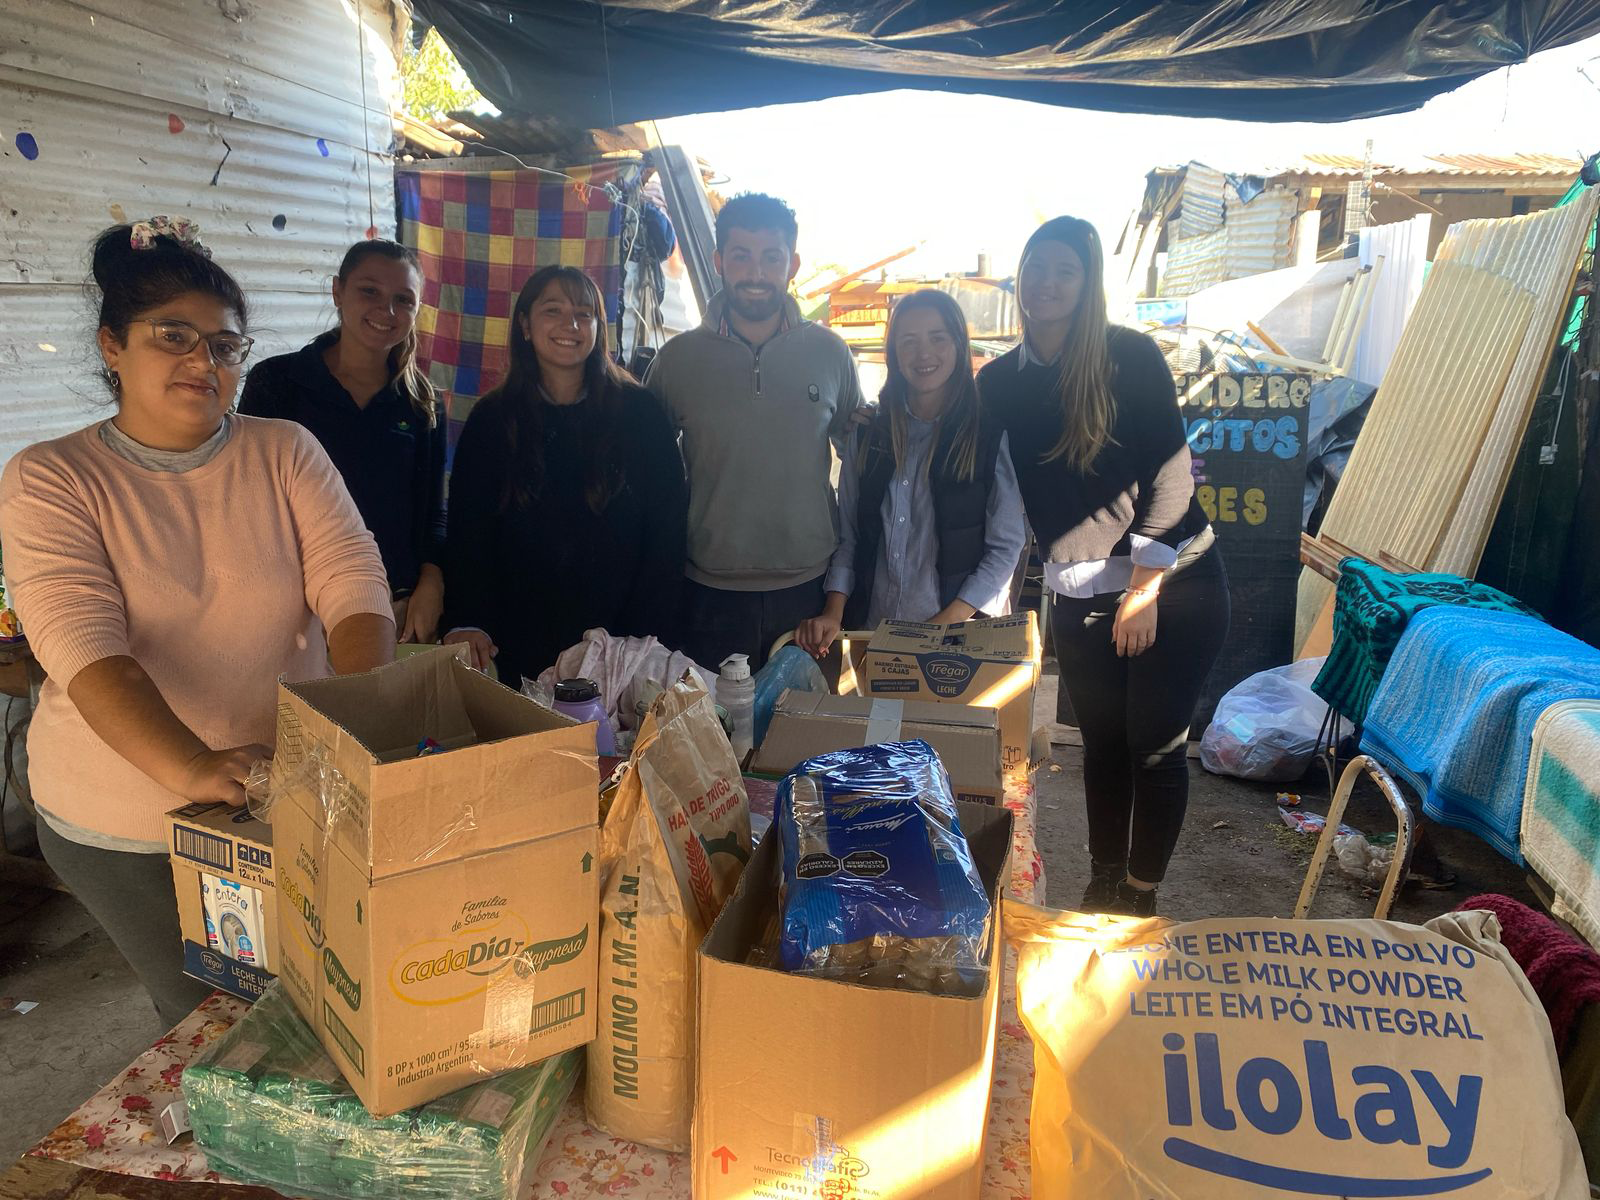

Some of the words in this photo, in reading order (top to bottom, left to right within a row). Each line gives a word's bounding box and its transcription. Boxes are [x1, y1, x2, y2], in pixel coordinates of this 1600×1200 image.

[1175, 375, 1311, 408] ENDERO
[1191, 459, 1206, 483] E
[1196, 485, 1268, 526] BES
[930, 663, 967, 679] Tregar
[936, 685, 957, 694] LECHE
[689, 796, 706, 816] DE
[706, 778, 731, 805] TRIGO
[709, 806, 726, 822] TIPO
[238, 861, 264, 873] CONTENIDO:
[215, 887, 249, 911] entera
[461, 895, 508, 915] Familia
[451, 920, 463, 932] de
[464, 910, 500, 926] Sabores
[202, 953, 223, 970] Tregar
[1208, 930, 1322, 959] ENTERA
[1329, 933, 1368, 961] EN
[1376, 940, 1476, 969] POLVO
[231, 965, 256, 983] LECHE
[324, 952, 359, 1004] Mayonesa
[1132, 958, 1241, 986] WHOLE
[1247, 961, 1322, 992] MILK
[1329, 968, 1467, 1003] POWDER
[238, 978, 264, 996] ENTER
[1130, 991, 1213, 1019] LEITE
[1220, 994, 1261, 1020] EM
[1272, 992, 1312, 1024] PÓ
[1322, 1005, 1484, 1041] INTEGRAL
[612, 993, 639, 1100] MOLINO
[387, 1066, 393, 1078] 8
[395, 1062, 407, 1076] DP
[409, 1061, 414, 1070] x
[416, 1051, 436, 1068] 1000
[397, 1064, 434, 1088] Industria
[435, 1051, 474, 1072] Argentina
[1162, 1032, 1483, 1168] ilolay
[775, 1180, 807, 1195] (011)
